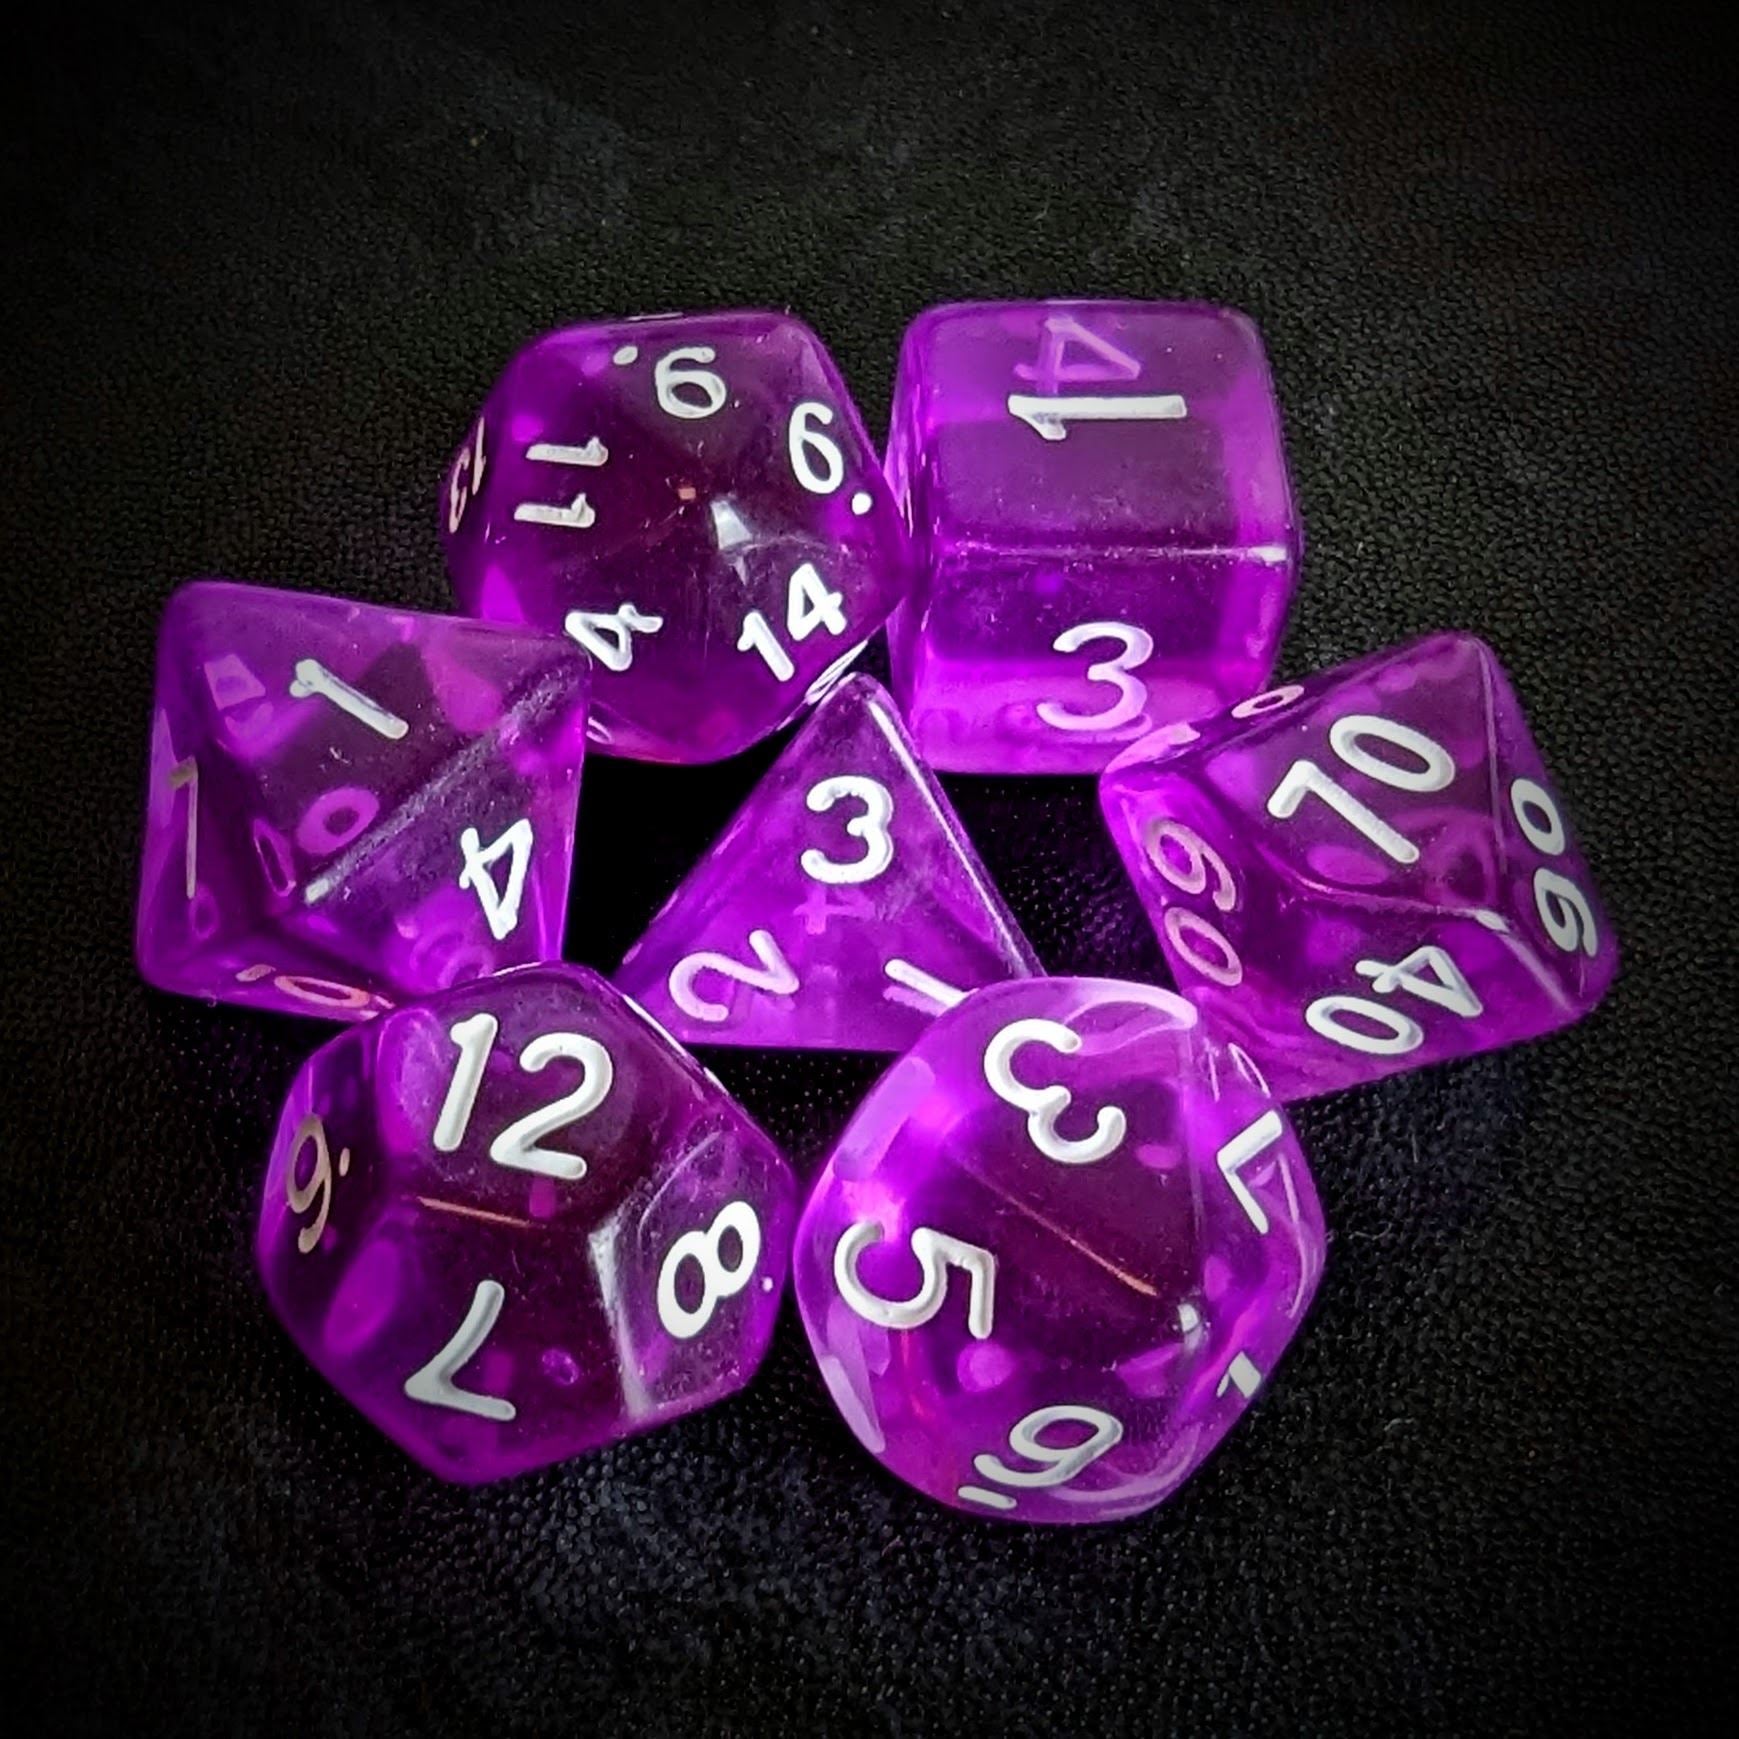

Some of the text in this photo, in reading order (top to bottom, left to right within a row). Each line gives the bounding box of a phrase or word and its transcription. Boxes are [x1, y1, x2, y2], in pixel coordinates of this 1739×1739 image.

[1008, 394, 1187, 440] 1
[514, 436, 609, 528] 11
[565, 603, 663, 671] 4
[737, 563, 846, 681] 14
[1036, 622, 1153, 731] 3
[289, 658, 409, 739] 1
[801, 776, 894, 884] 3
[1267, 715, 1456, 863] 70
[459, 818, 533, 940] 4
[669, 930, 799, 1022] 2
[1306, 946, 1483, 1055] 40
[433, 1013, 613, 1180] 12
[980, 1018, 1126, 1164] 3
[1217, 1110, 1282, 1235] 7
[834, 1220, 994, 1338] 5
[404, 1280, 517, 1421] 7
